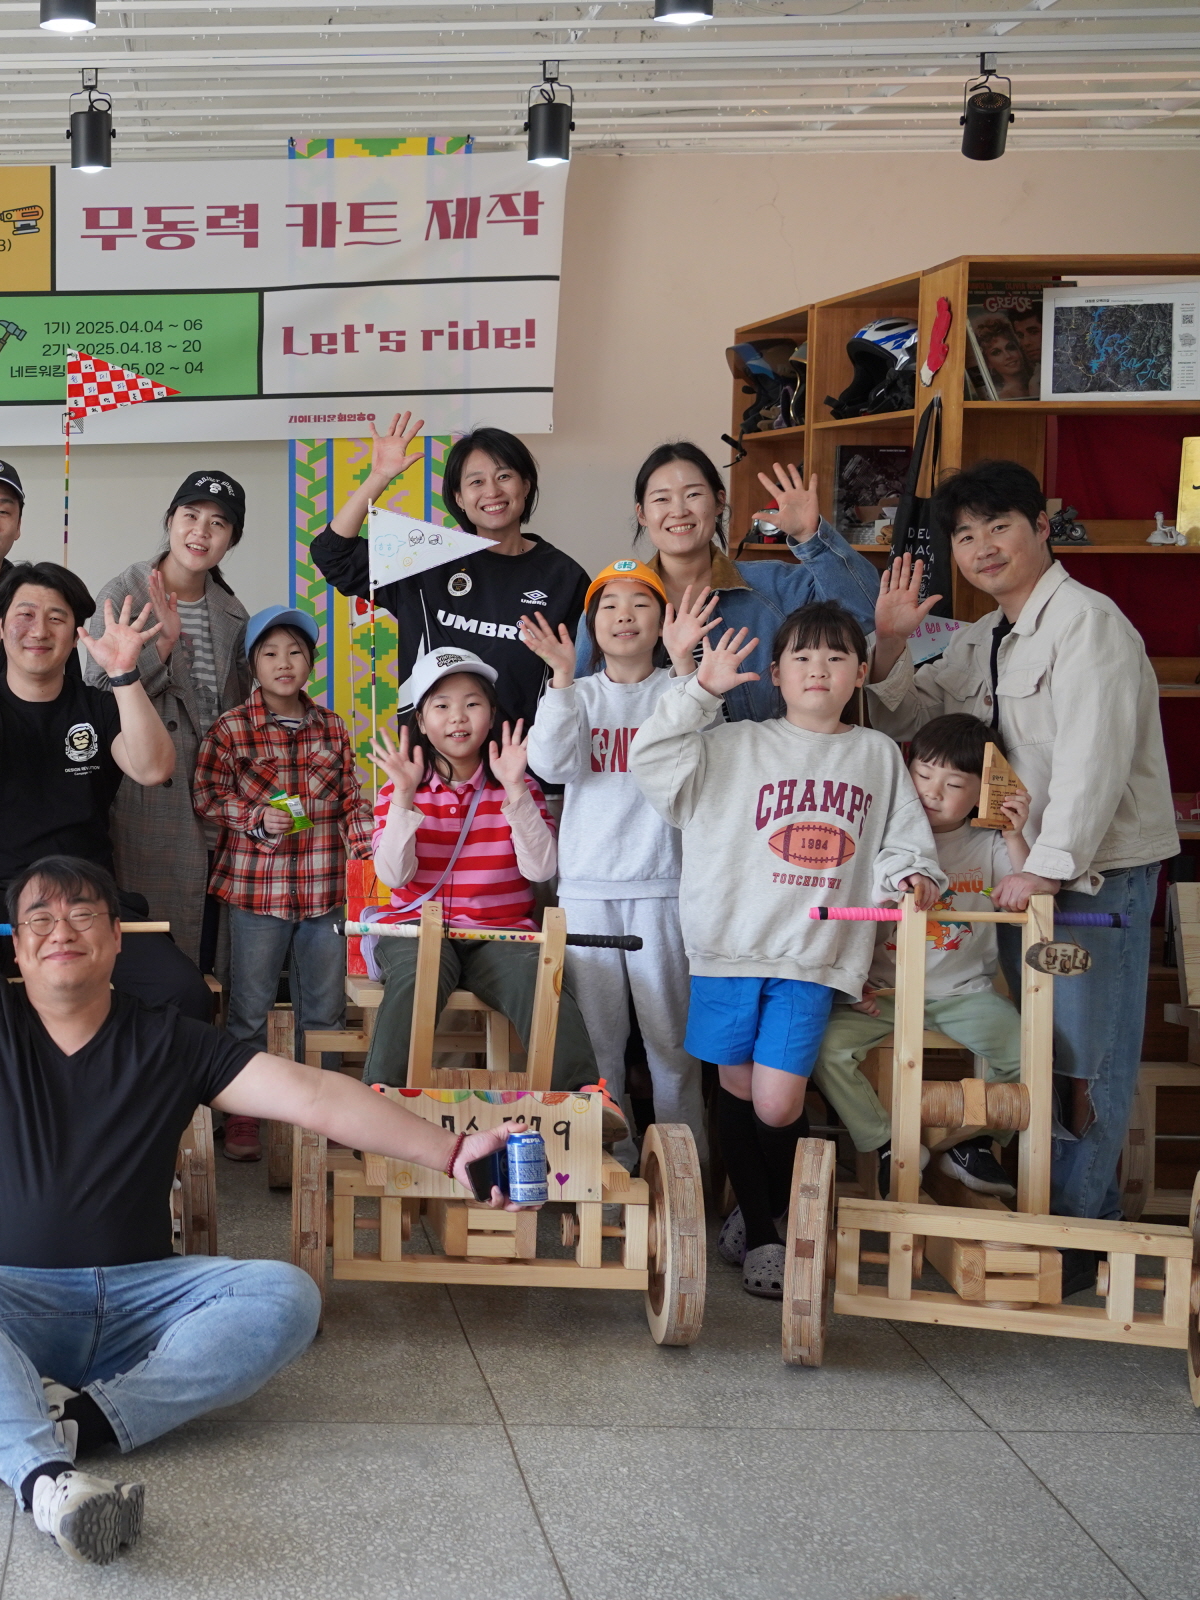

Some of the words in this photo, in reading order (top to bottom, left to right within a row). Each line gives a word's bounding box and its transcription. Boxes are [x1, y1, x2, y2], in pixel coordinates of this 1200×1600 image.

[80, 203, 259, 251] 무동력
[285, 200, 401, 247] 카트
[425, 190, 545, 241] 제작
[985, 294, 1033, 313] GREASE
[43, 321, 71, 335] 1기)
[75, 320, 164, 335] 2025.04.04
[183, 318, 203, 332] 06
[282, 321, 407, 356] Let's
[421, 318, 537, 351] ride!
[76, 340, 163, 357] 2025.04.18
[182, 339, 202, 353] 20
[10, 364, 66, 379] 네트워킹
[184, 361, 204, 375] 04
[520, 598, 548, 607] UMBRO
[755, 779, 873, 840] CHAMPS
[801, 837, 830, 851] 1984
